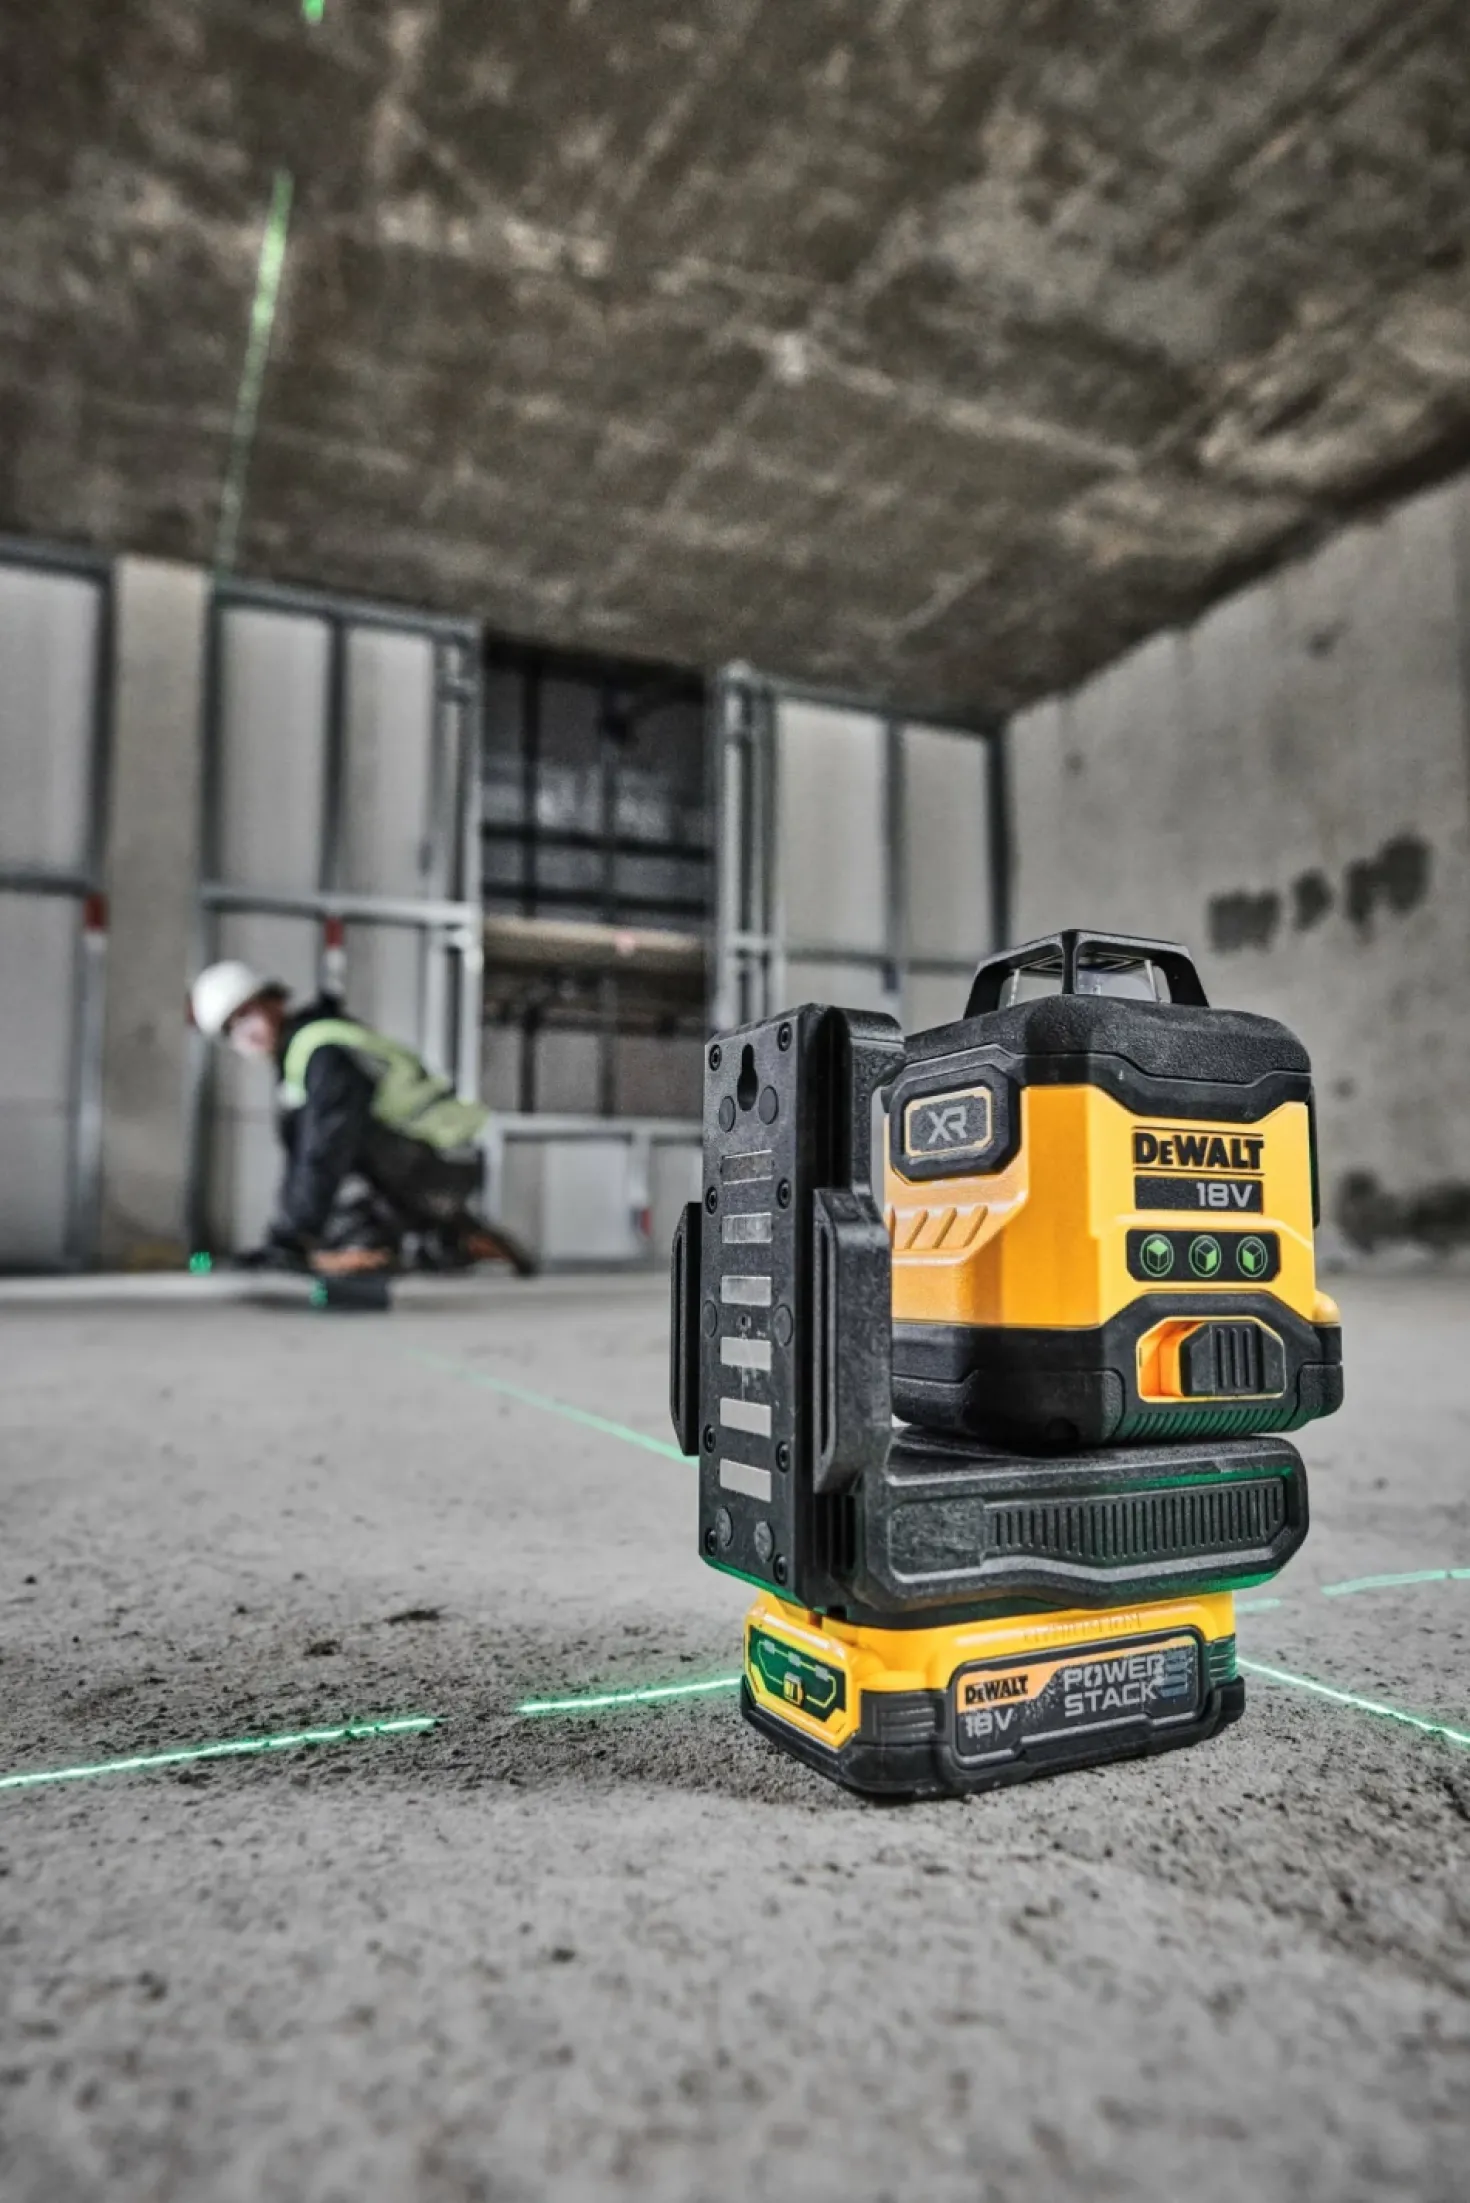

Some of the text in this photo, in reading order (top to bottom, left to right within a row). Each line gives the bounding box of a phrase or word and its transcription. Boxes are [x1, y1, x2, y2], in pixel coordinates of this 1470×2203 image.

[927, 1105, 967, 1144] XR
[1133, 1132, 1265, 1169] DEWALT
[1196, 1181, 1252, 1208] 18V
[965, 1675, 1028, 1705] DEWALT
[1064, 1654, 1165, 1692] POWER
[1064, 1681, 1157, 1717] STACK
[966, 1708, 1014, 1738] 18V
